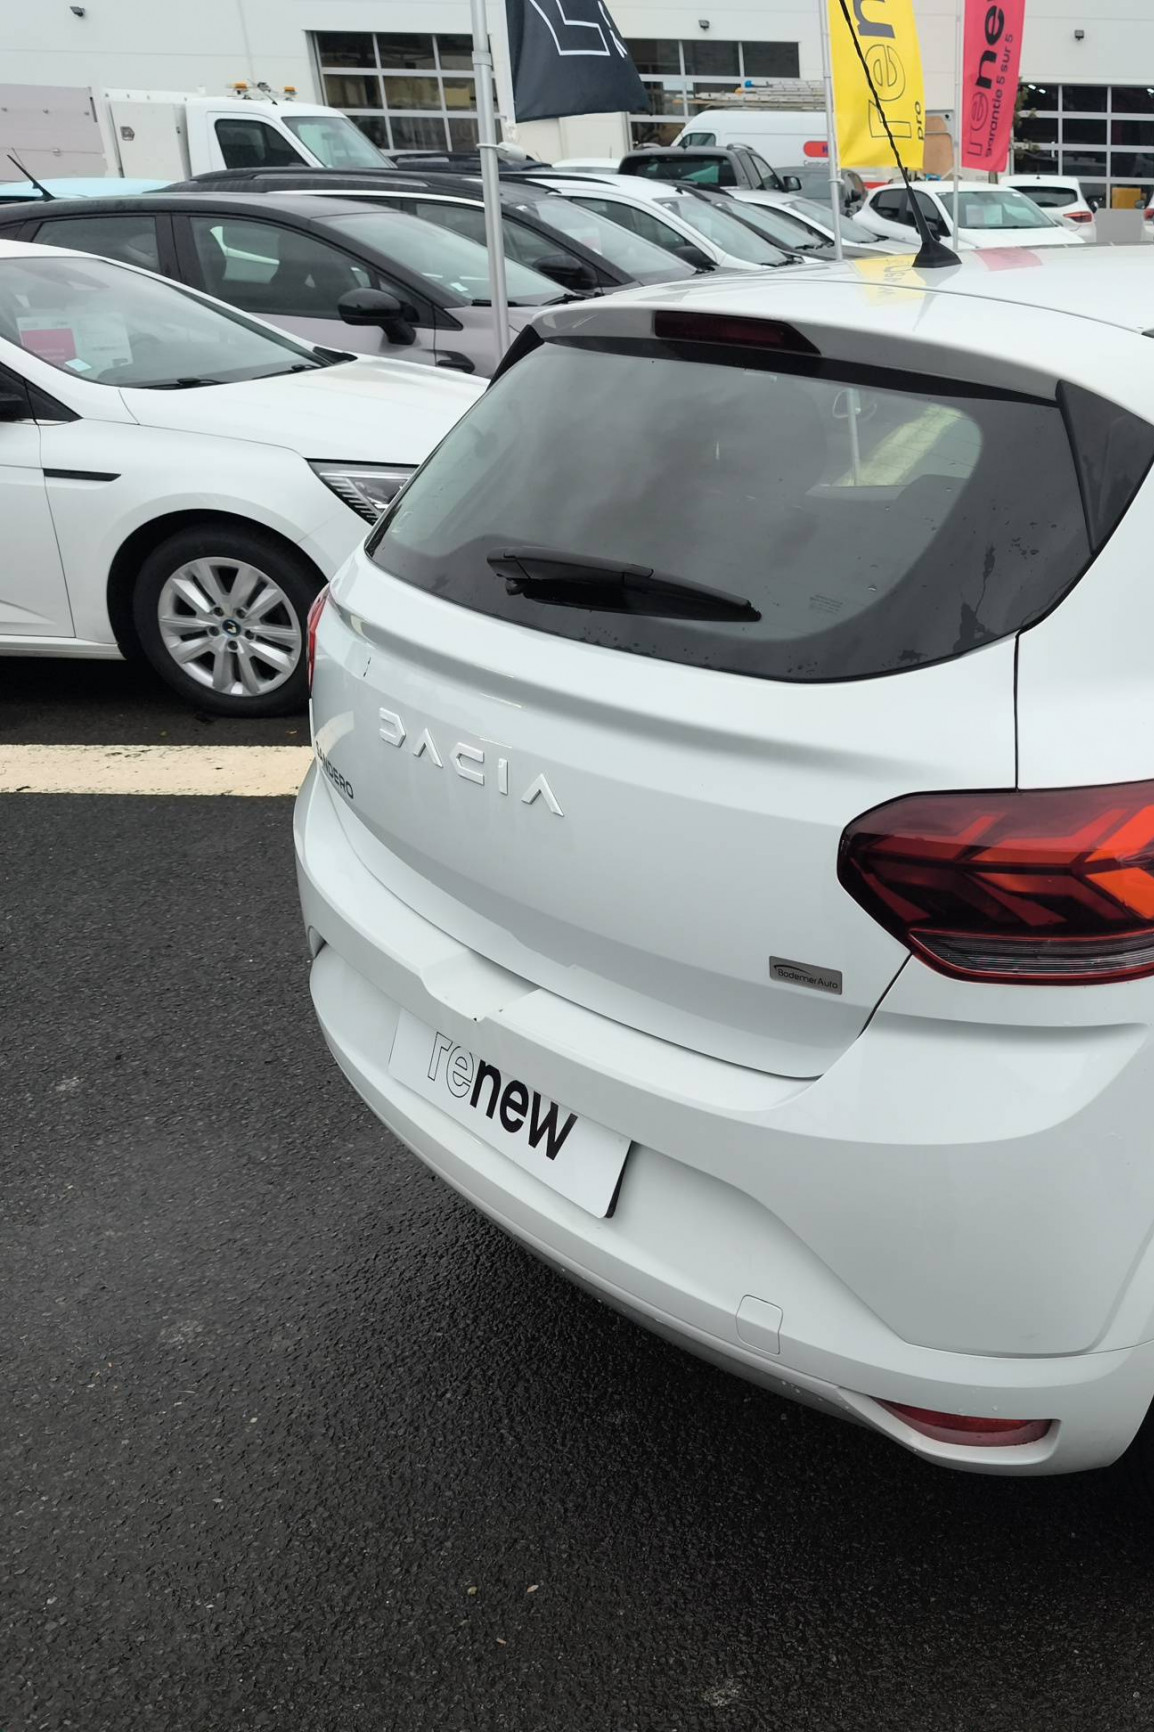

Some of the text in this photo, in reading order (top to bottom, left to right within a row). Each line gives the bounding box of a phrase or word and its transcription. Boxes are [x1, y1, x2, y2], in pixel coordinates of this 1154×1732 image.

[915, 100, 925, 140] pro
[966, 0, 1004, 156] rene
[985, 89, 1003, 157] garantie
[1001, 50, 1012, 73] sur
[379, 707, 564, 817] DACIA
[817, 977, 838, 989] Auto
[427, 1031, 579, 1161] renew
